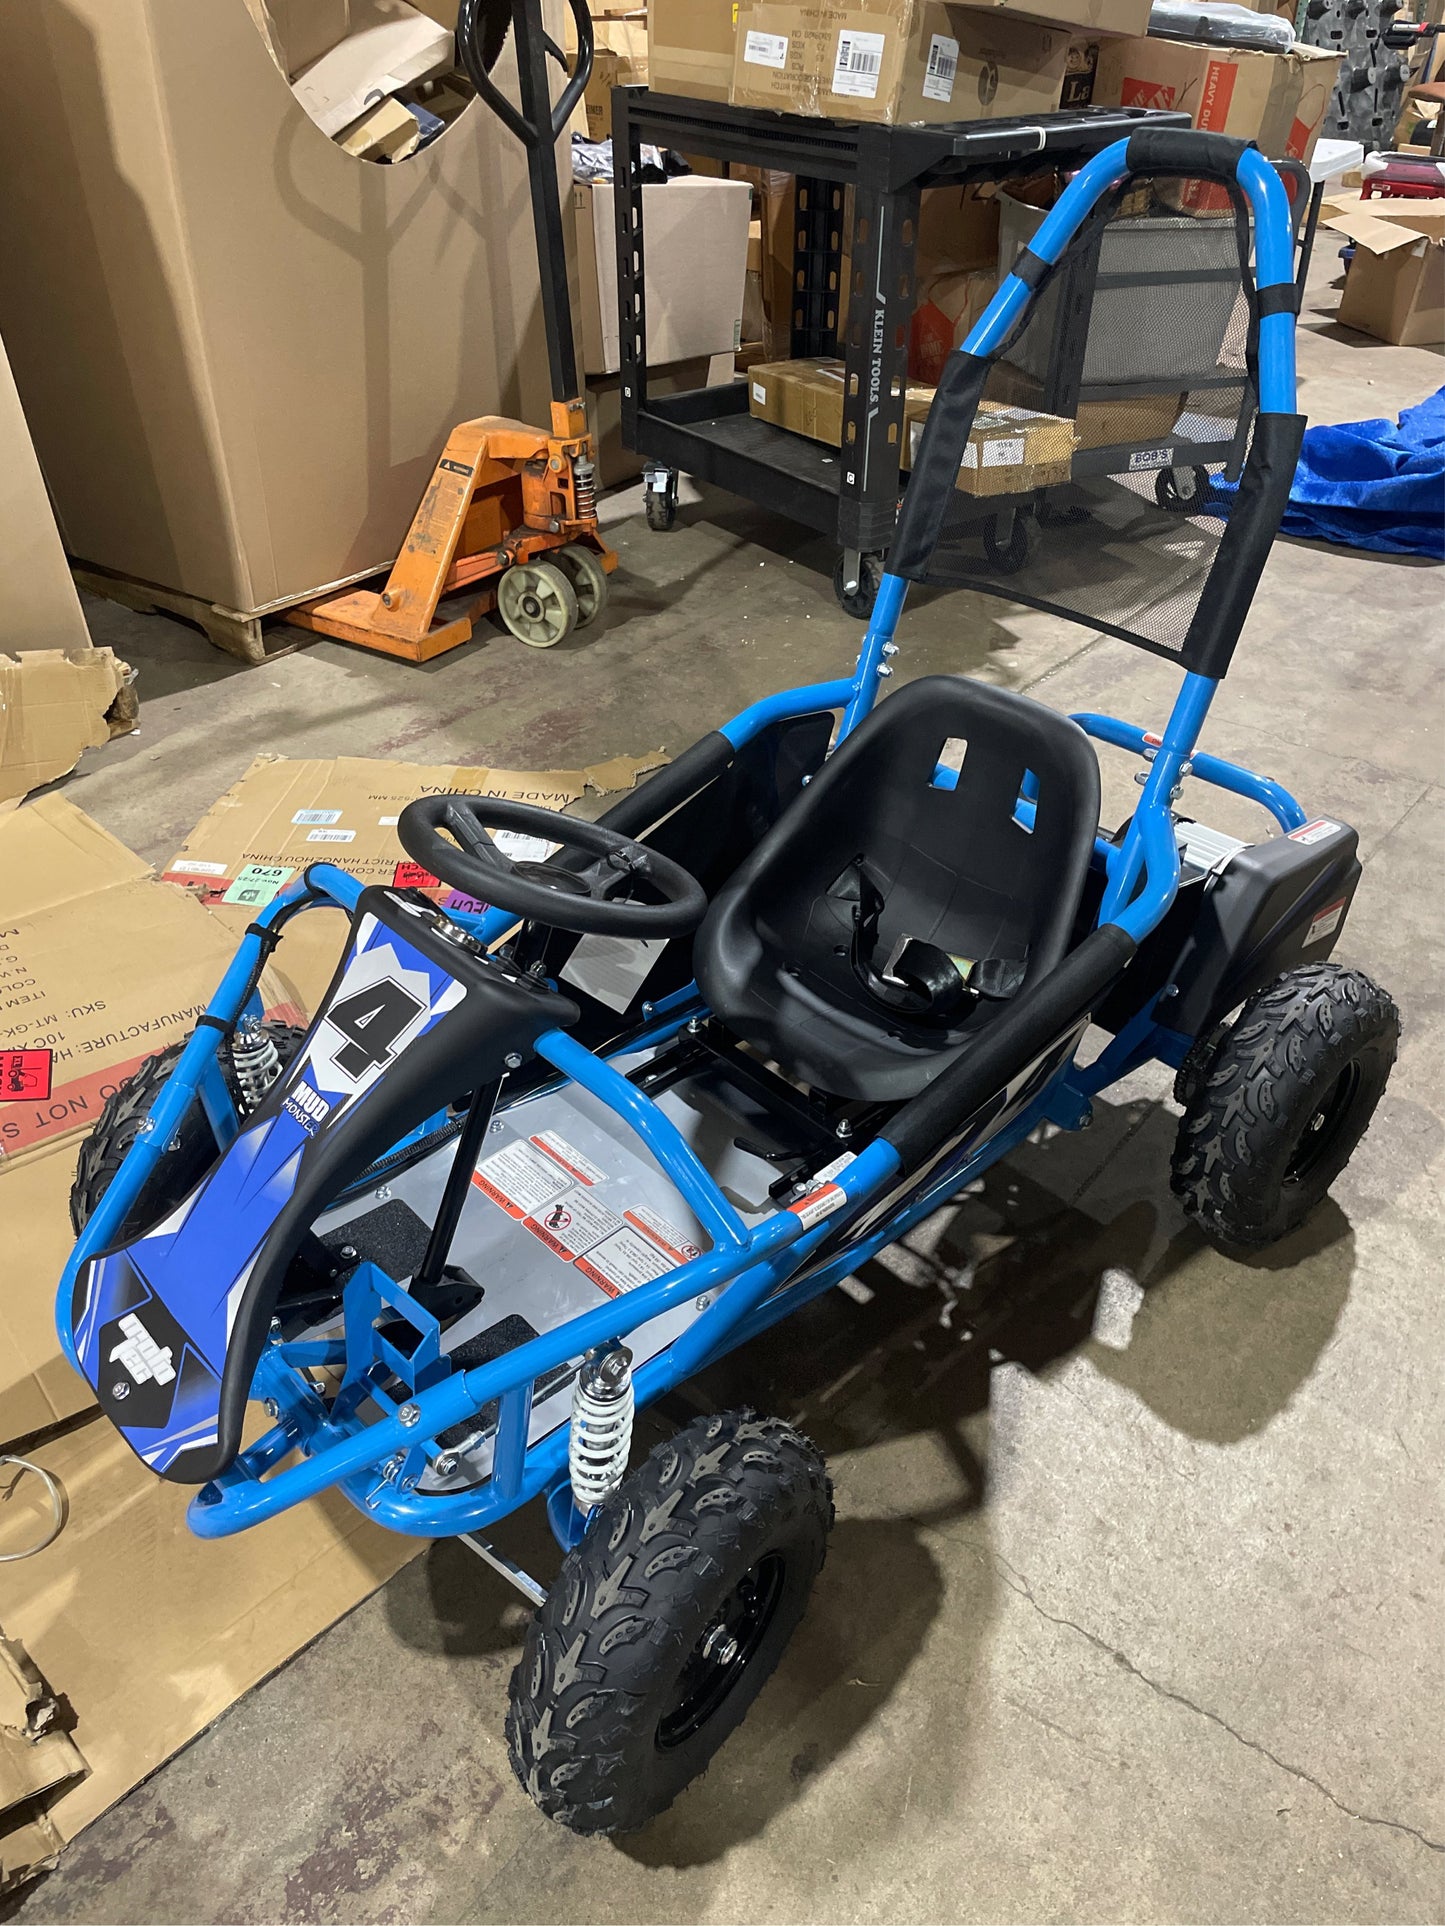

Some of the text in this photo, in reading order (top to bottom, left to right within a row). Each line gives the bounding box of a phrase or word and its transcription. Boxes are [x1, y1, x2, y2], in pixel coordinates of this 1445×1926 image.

[1206, 66, 1221, 106] HEAVY
[869, 309, 885, 402] KLEIN TOOLS
[419, 785, 570, 804] MADE IN CHINA
[241, 853, 282, 863] CHINA
[282, 854, 360, 866] HANGZHOU
[252, 867, 282, 877] 670
[6, 990, 46, 1008] ITEM
[65, 1000, 106, 1018] SKU:
[33, 1031, 65, 1048] 10C
[77, 1004, 207, 1054] MANUFACTURE:
[323, 975, 428, 1084] 4
[34, 1095, 88, 1128] NOT
[291, 1081, 331, 1123] MUD
[282, 1097, 320, 1138] MONSTER
[478, 1179, 507, 1206] WARNING
[530, 1223, 560, 1250] WARNING
[585, 1266, 616, 1294] WARNING
